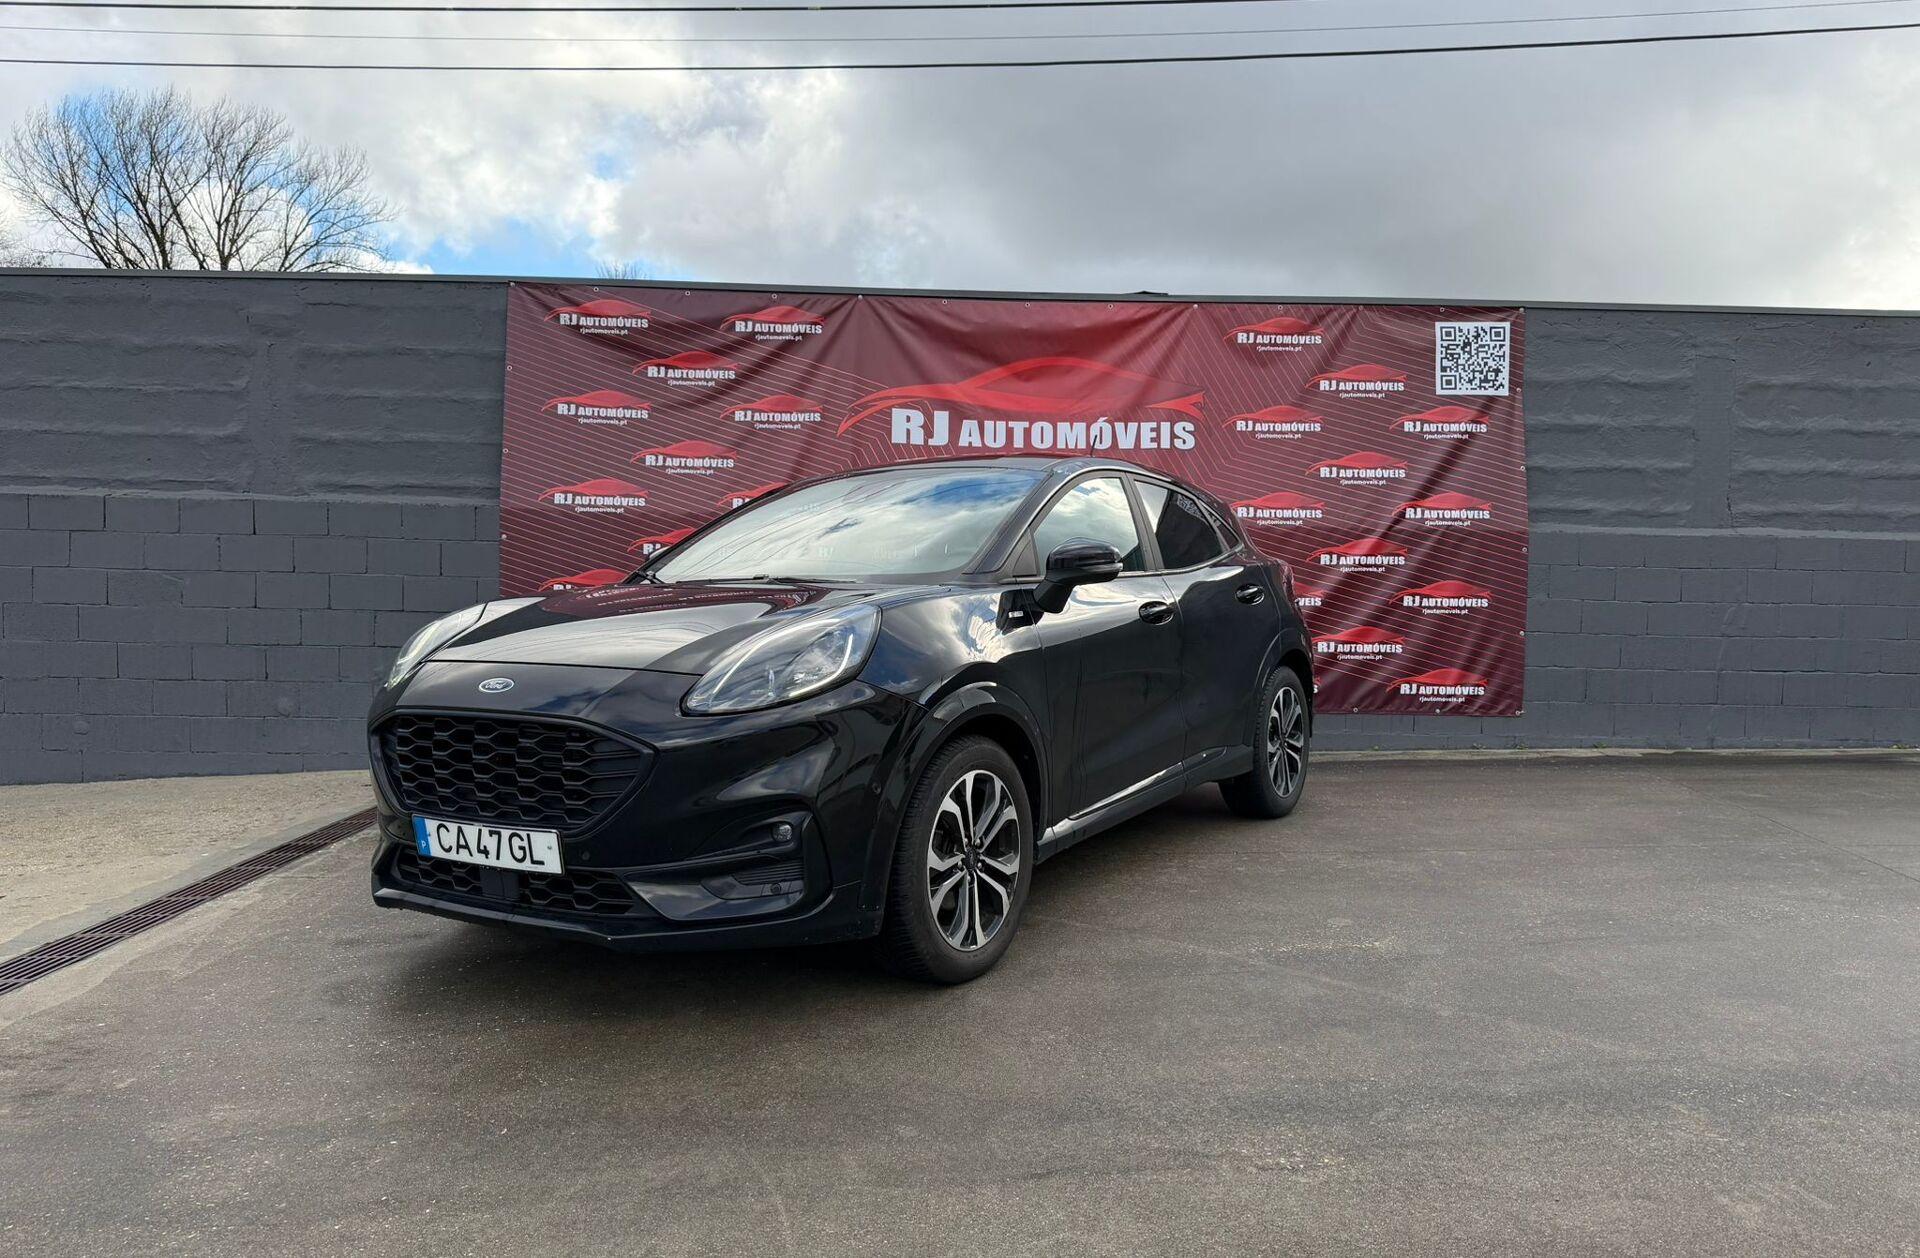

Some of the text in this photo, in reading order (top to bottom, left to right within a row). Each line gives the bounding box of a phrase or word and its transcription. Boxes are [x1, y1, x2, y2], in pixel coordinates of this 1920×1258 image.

[560, 314, 648, 328] RJ AUTOMÓVEIS
[735, 321, 822, 334] RJ AUTOMÓVEIS
[1238, 333, 1321, 344] RJ AUTOMÓVEIS
[648, 366, 735, 379] RJ AUTOMÓVEIS
[1320, 380, 1404, 391] RJ AUTOMÓVEIS
[557, 404, 648, 419] RJ AUTOMÓVEIS
[735, 410, 821, 422] RJ AUTOMÓVEIS
[891, 408, 1196, 450] RJ AUTOMÓVEIS
[1236, 421, 1321, 432] RJ AUTOMÓVEIS
[1404, 421, 1487, 432] RJ AUTOMÓVEIS
[645, 455, 734, 468] RJ AUTOMÓVEIS
[1320, 467, 1405, 478] RJ AUTOMÓVEIS
[554, 493, 645, 507] RJ AUTOMÓVEIS
[1237, 507, 1322, 518] RJ AUTOMÓVEIS
[1405, 508, 1490, 519] RJ AUTOMÓVEIS
[1320, 555, 1405, 565] RJ AUTOMÓVEIS
[1403, 596, 1488, 608] RJ AUTOMÓVEIS
[1318, 642, 1403, 653] RJ AUTOMÓVEIS
[1400, 684, 1485, 696] RJ AUTOMÓVEIS
